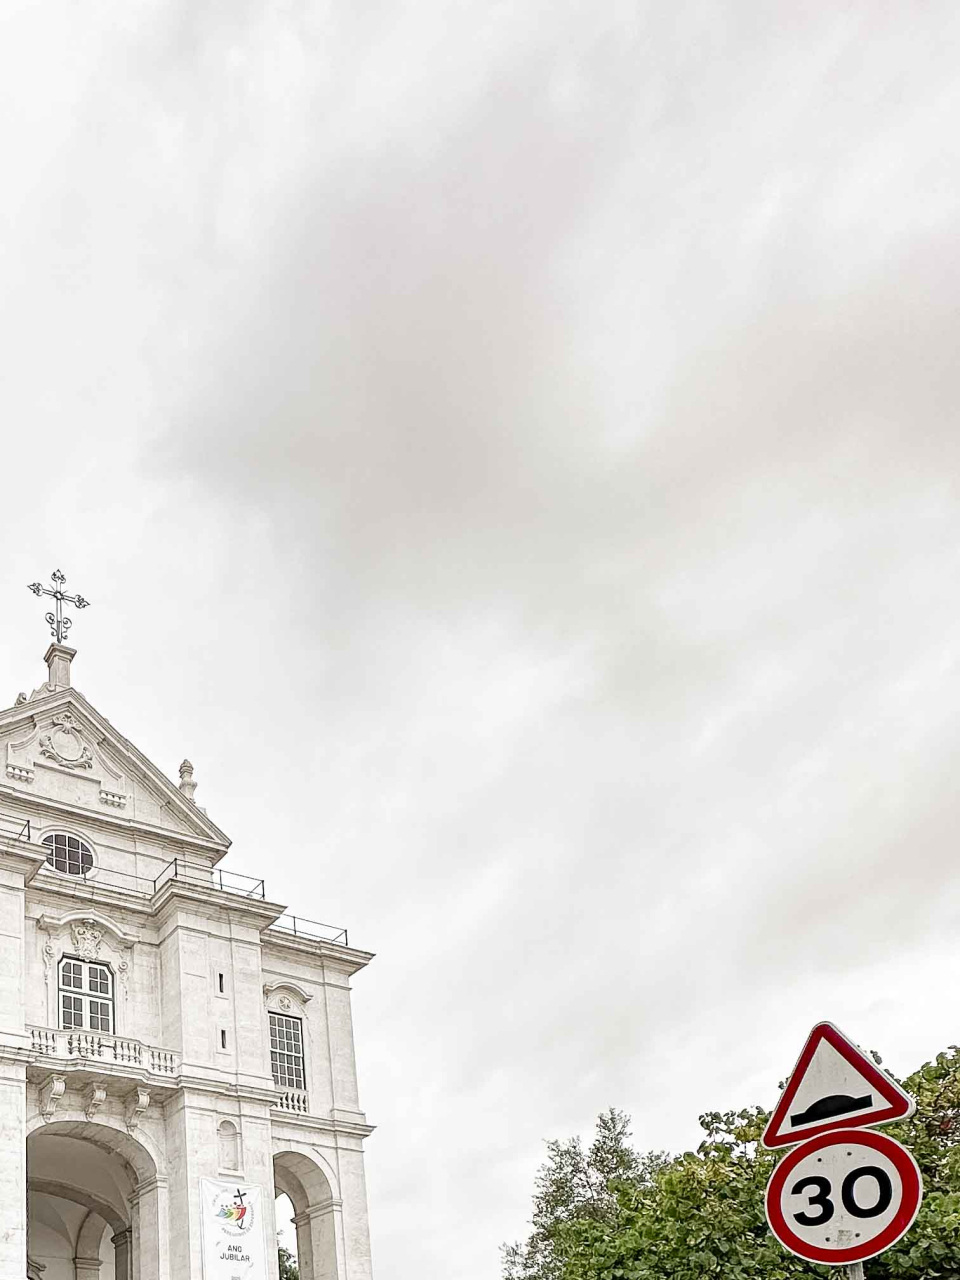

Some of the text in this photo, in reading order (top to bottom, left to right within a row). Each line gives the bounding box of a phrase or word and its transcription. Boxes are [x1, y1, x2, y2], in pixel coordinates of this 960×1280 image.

[791, 1166, 893, 1227] 30
[228, 1245, 242, 1253] ANO
[220, 1252, 250, 1262] JUBILAR
